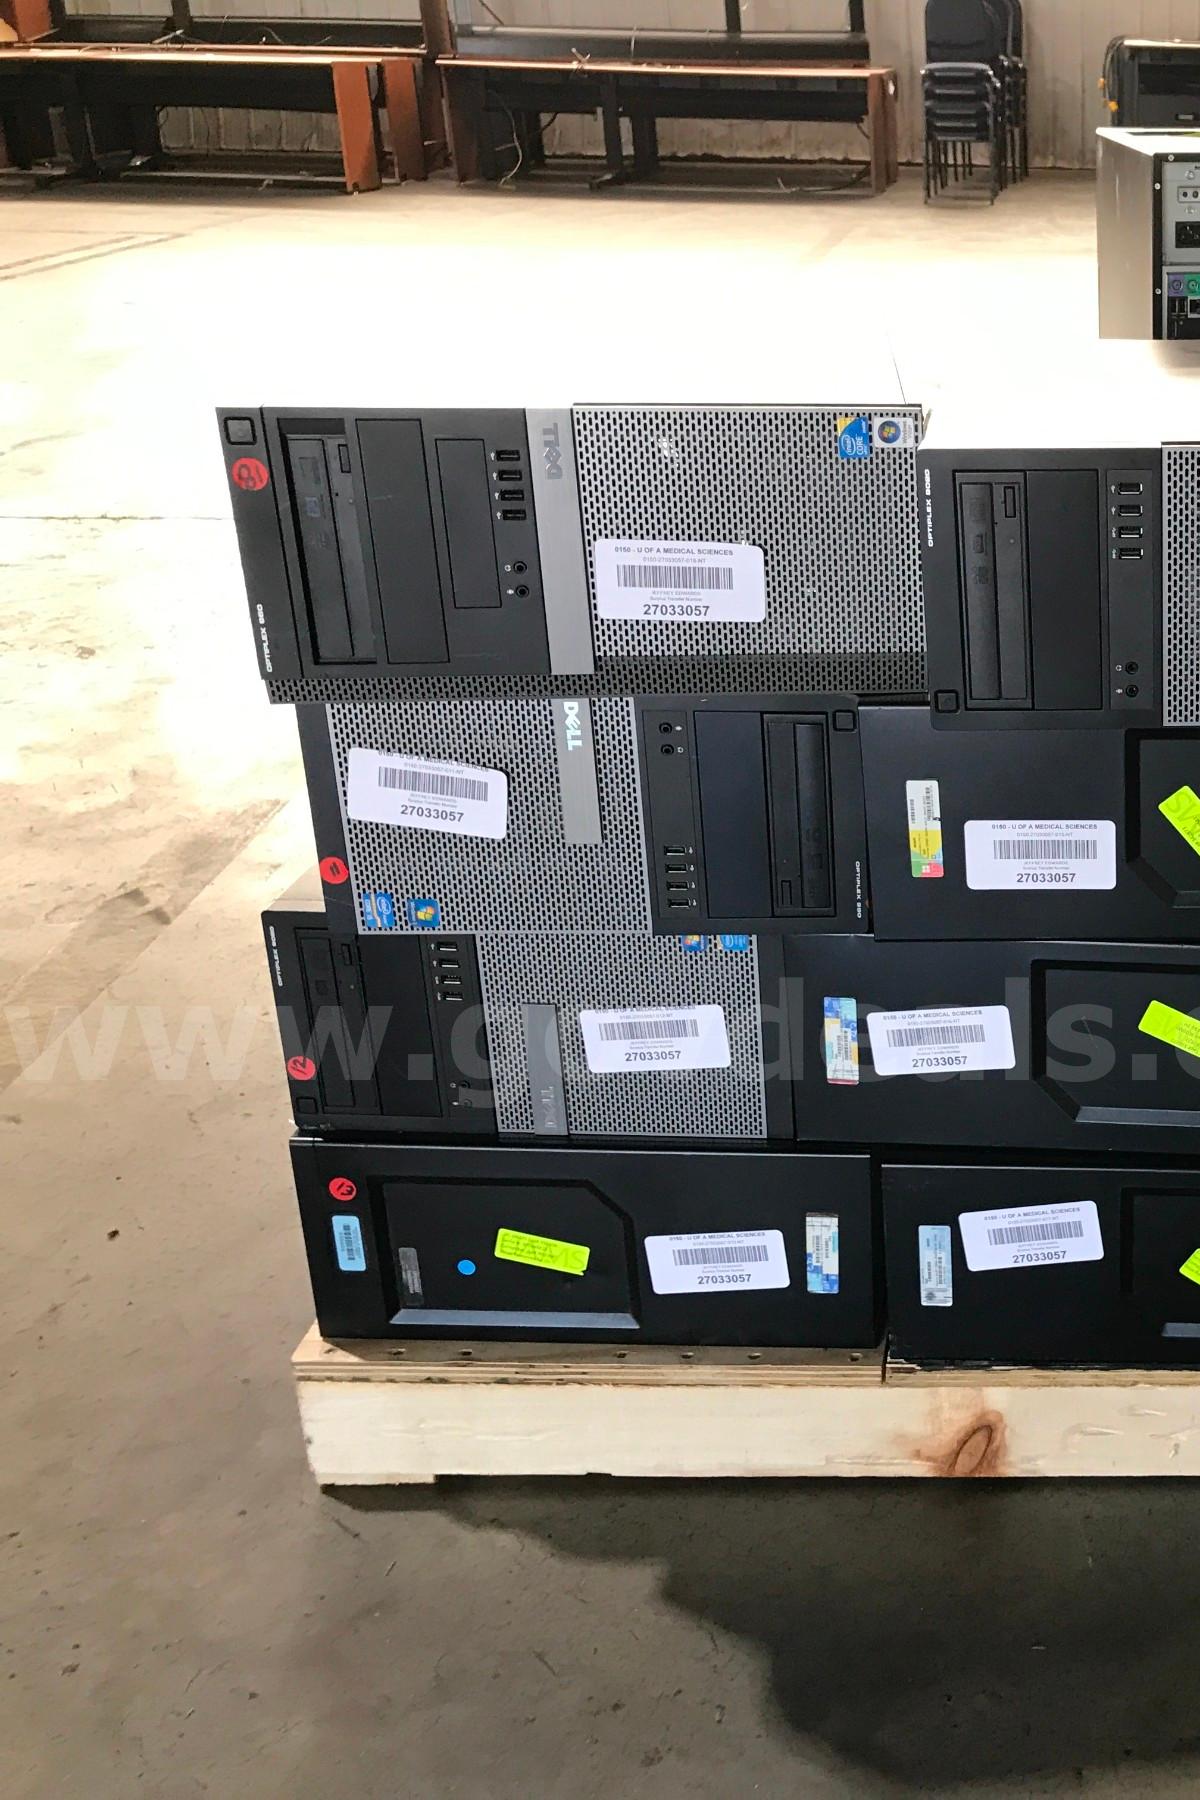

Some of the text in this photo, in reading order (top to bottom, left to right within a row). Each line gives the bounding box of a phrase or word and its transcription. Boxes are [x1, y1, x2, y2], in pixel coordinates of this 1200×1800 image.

[543, 423, 563, 479] DELL
[925, 499, 934, 547] OPTIPLEX
[697, 548, 733, 556] SCIENCES
[643, 603, 709, 617] 27033057
[260, 626, 273, 673] OPTIPLEX
[563, 701, 584, 750] DELL
[400, 803, 463, 823] 27033057
[1016, 873, 1075, 882] 27033057
[271, 949, 283, 987] OPTIPLEX
[624, 1050, 680, 1061] 27033057
[911, 1056, 967, 1067] 27033057
[1012, 1250, 1066, 1263] 27033057
[697, 1273, 751, 1284] 27033057
